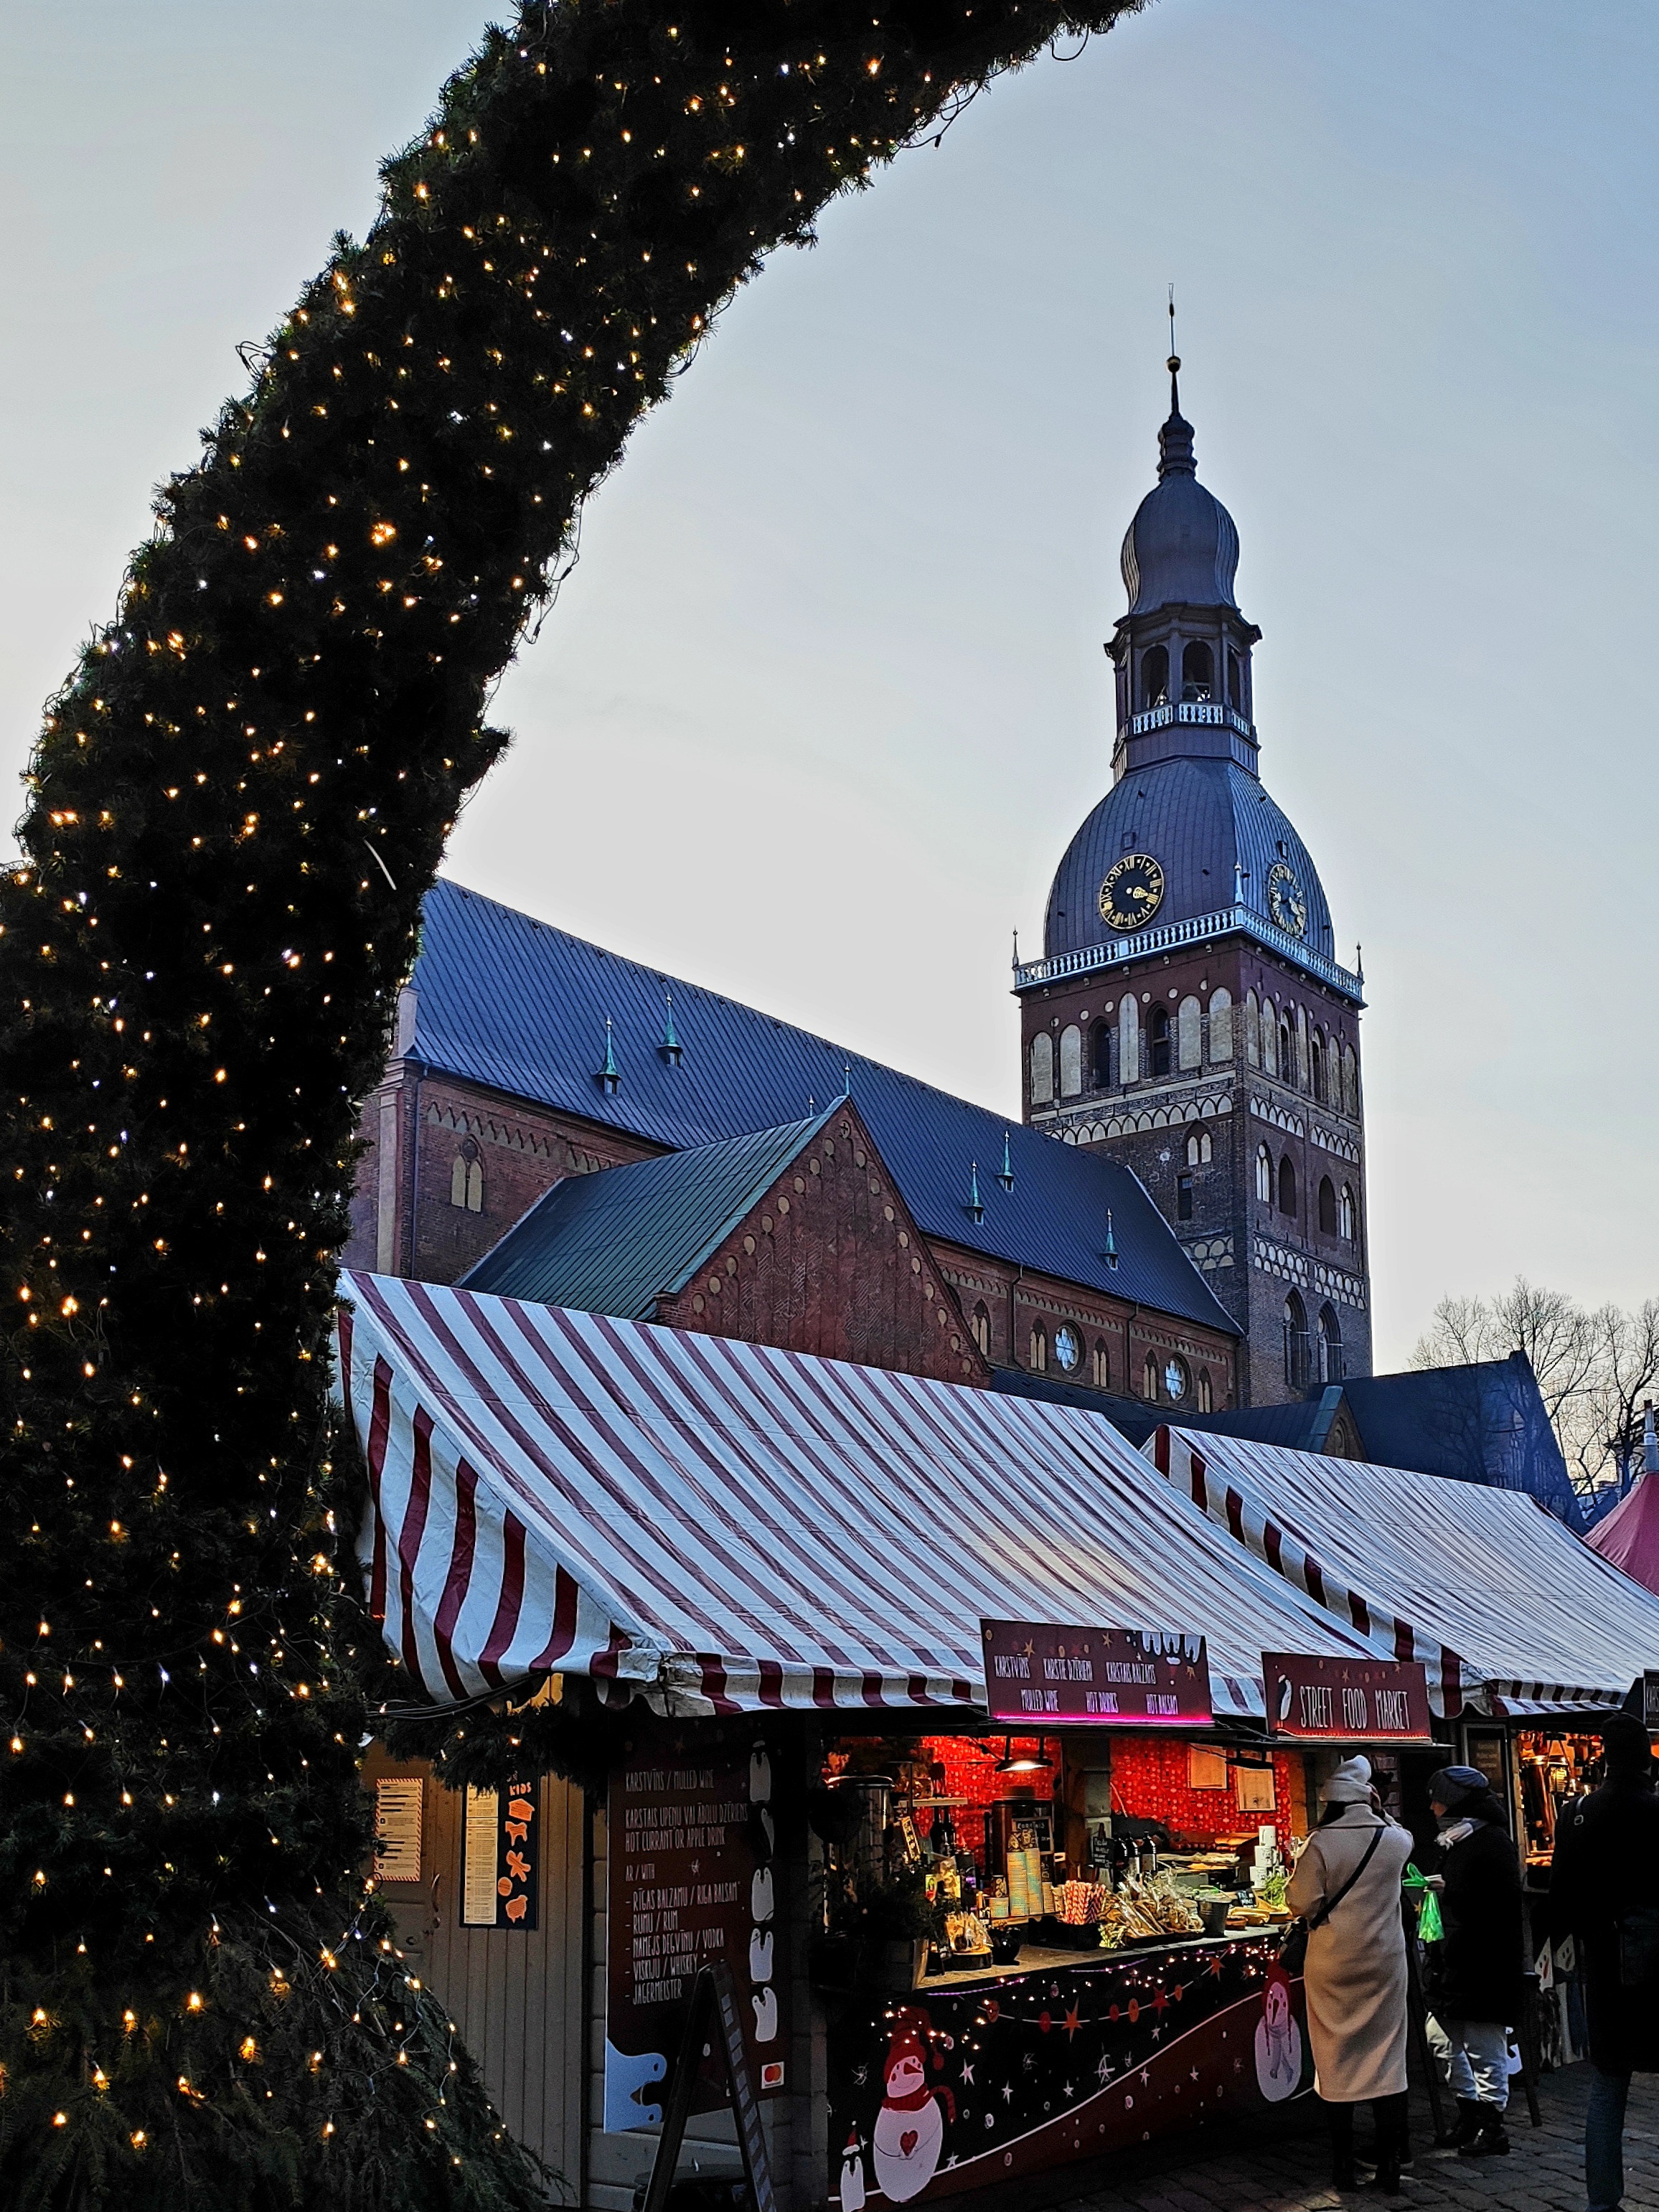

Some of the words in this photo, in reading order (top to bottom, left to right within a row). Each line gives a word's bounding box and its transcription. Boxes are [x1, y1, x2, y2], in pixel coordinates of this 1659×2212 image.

[994, 1653, 1031, 1679] KARSTVĪNS
[1043, 1657, 1068, 1680] KARSTIE
[1106, 1661, 1132, 1684] KARSTAIS
[1020, 1689, 1043, 1712] MULLED
[1043, 1690, 1060, 1712] WINE
[1086, 1691, 1099, 1713] HOT
[1098, 1692, 1119, 1713] DRINKS
[1146, 1693, 1158, 1715] HOT
[1158, 1694, 1179, 1715] BALSAM
[1300, 1685, 1334, 1728] STREET
[1342, 1688, 1368, 1729] FOOD
[1375, 1689, 1410, 1730] MARKET
[509, 1782, 532, 1796] KIDS
[626, 1769, 664, 1792] KARSTVĪNS
[673, 1769, 697, 1791] MULLED
[699, 1769, 715, 1789] WINE
[625, 1807, 658, 1830] KARSTAIS
[684, 1805, 695, 1825] VAI
[625, 1832, 639, 1853] HOT
[641, 1829, 673, 1852] CURRANT
[675, 1828, 685, 1849] OR
[687, 1827, 705, 1848] APPLE
[707, 1826, 725, 1846] DRINK
[625, 1865, 634, 1882] AR
[641, 1863, 655, 1881] WITH
[633, 1887, 655, 1911] RĪGAS
[657, 1886, 688, 1909] BALZAMU
[697, 1884, 713, 1905] RIGA
[633, 1911, 654, 1935] RUMU
[663, 1910, 678, 1931] RUM
[633, 1935, 660, 1959] NAMEJS
[662, 1929, 693, 1954] DEGVĪNU
[702, 1927, 724, 1950] VODKA
[633, 1958, 660, 1982] VISKIJU
[669, 1953, 698, 1977] WHISKEY
[632, 1978, 682, 2005] JAGERMEISTER
